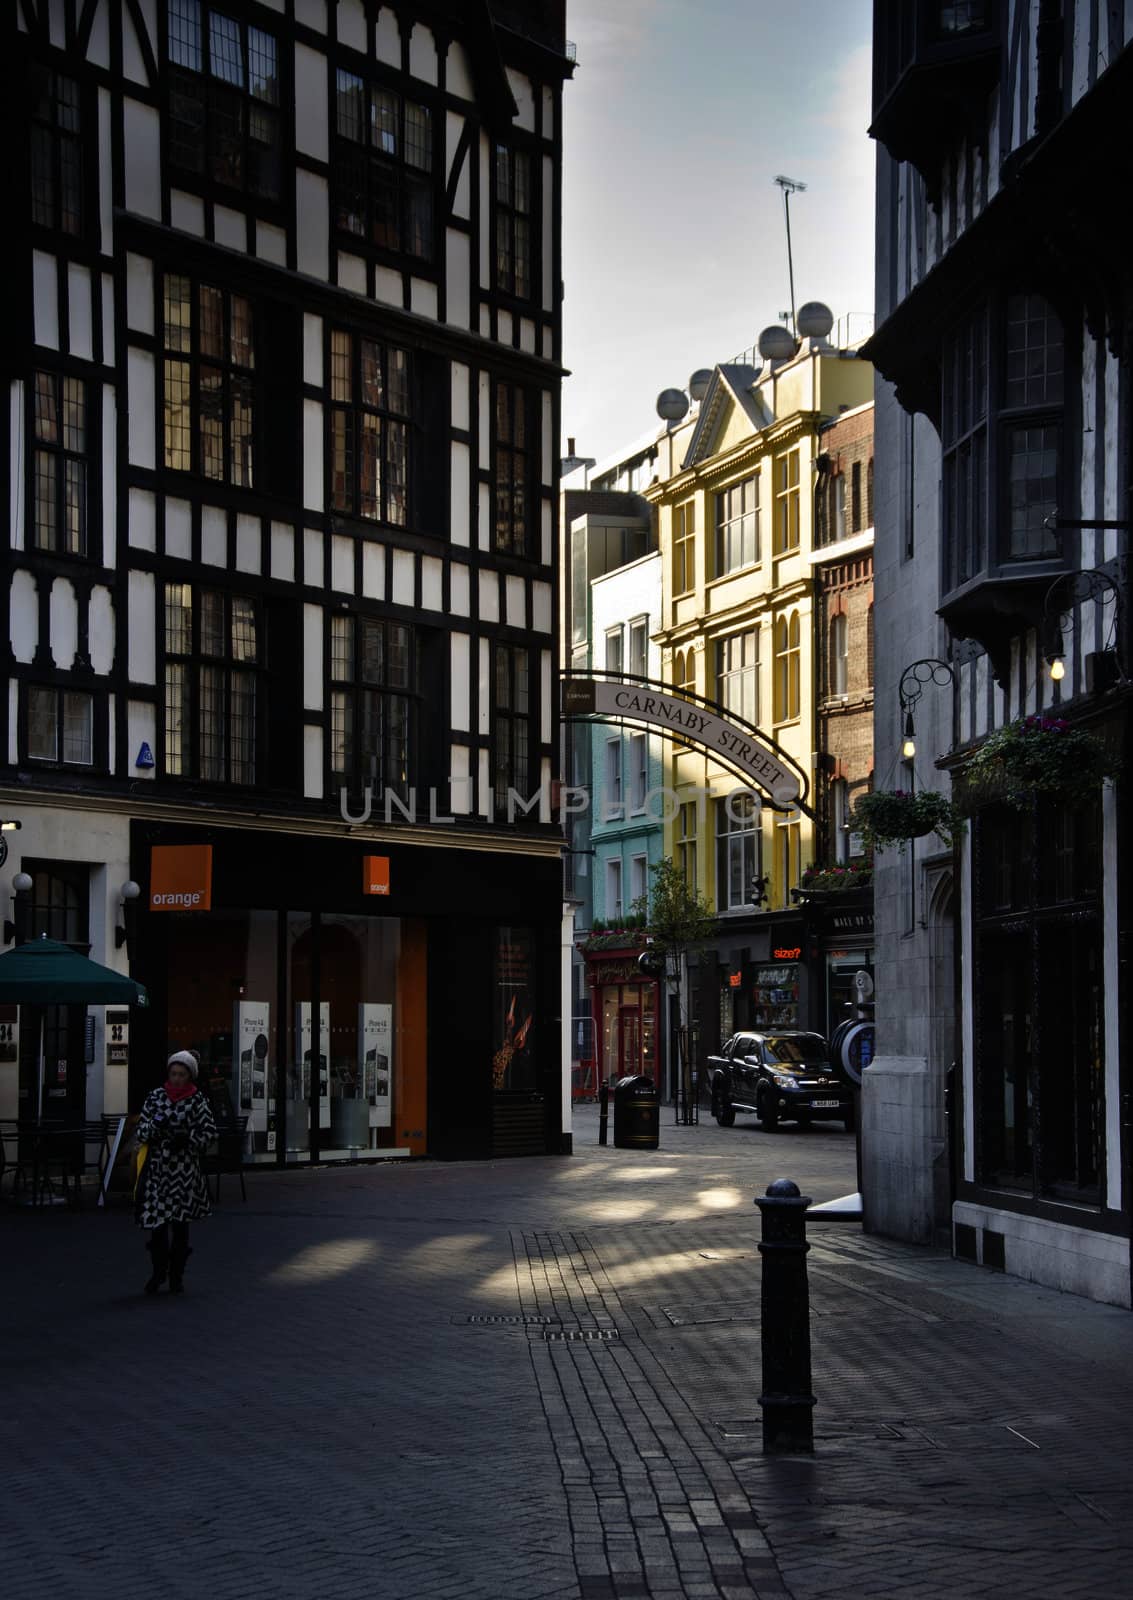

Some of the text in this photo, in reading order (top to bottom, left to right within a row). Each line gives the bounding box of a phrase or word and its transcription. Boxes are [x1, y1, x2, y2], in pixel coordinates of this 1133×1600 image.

[615, 691, 784, 785] CARNABY STREET
[152, 892, 201, 908] orange
[773, 947, 802, 959] size?
[111, 1024, 123, 1041] 32
